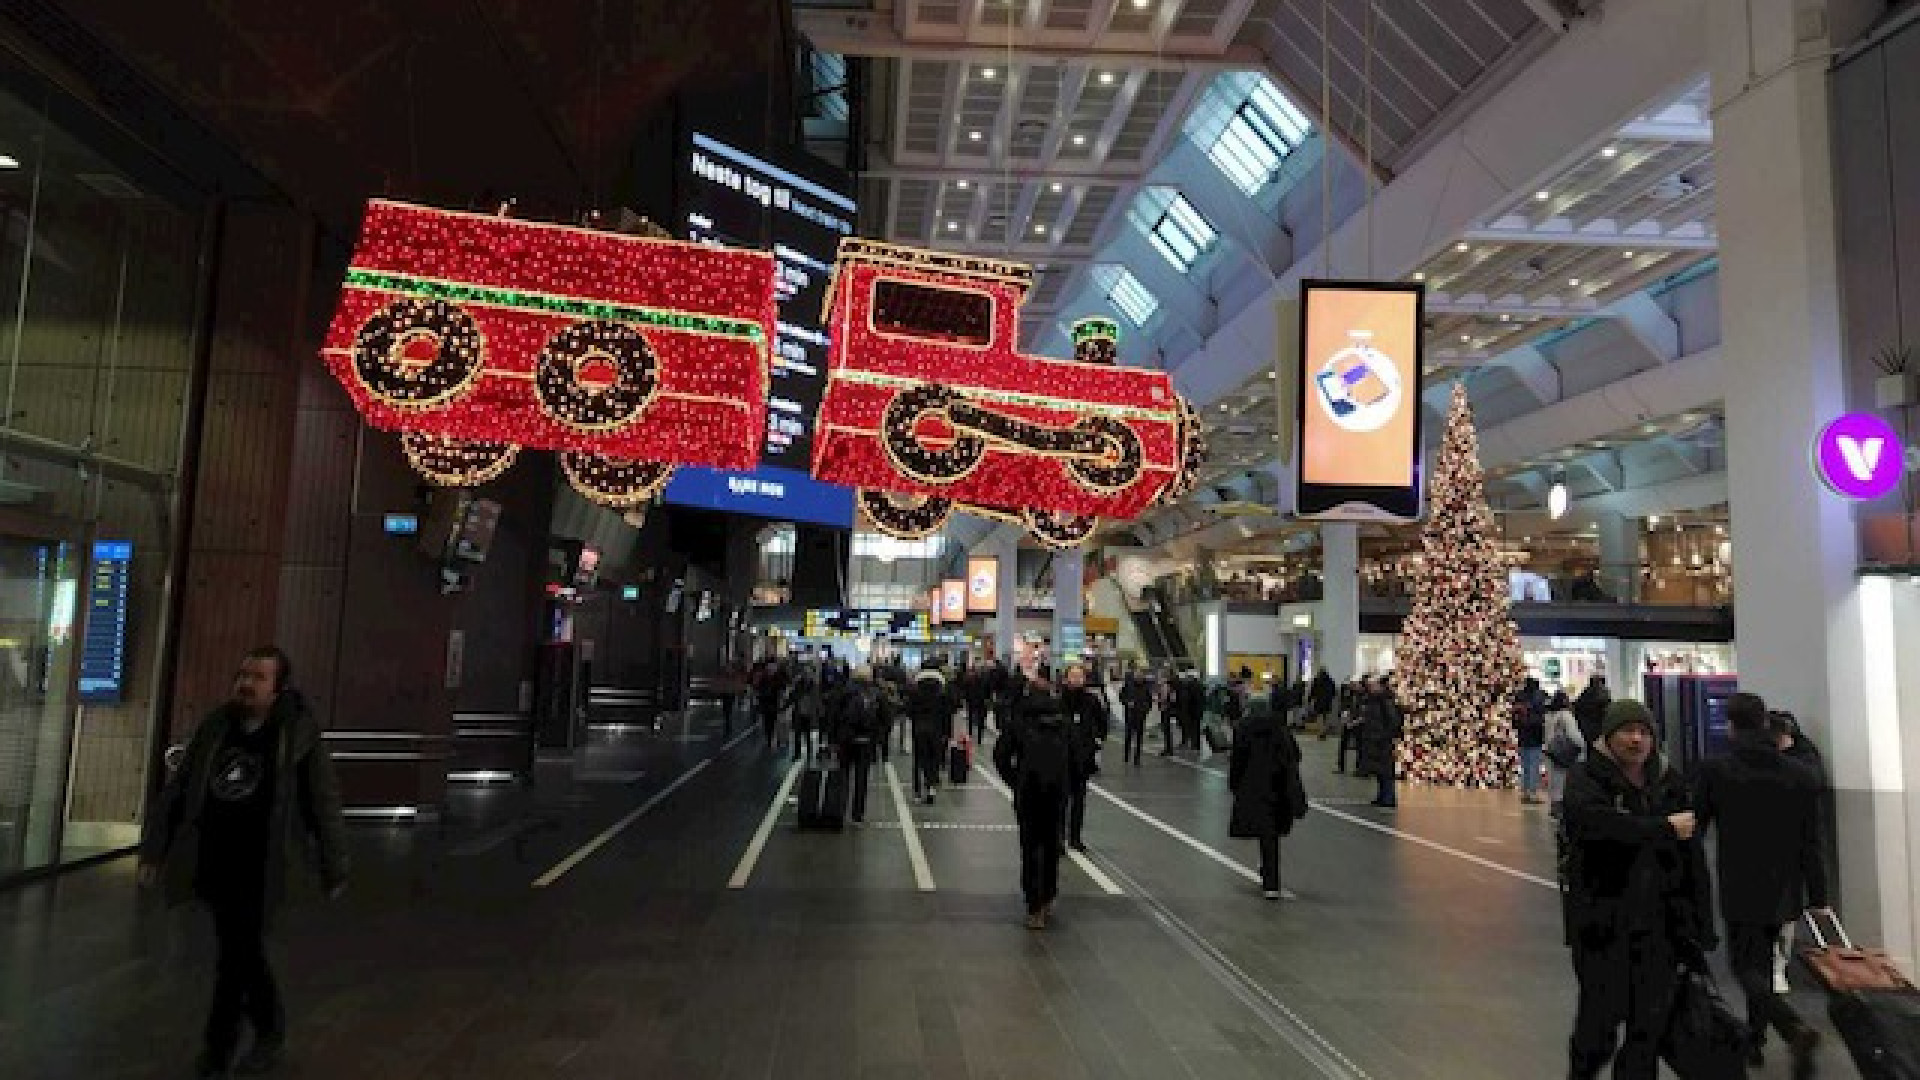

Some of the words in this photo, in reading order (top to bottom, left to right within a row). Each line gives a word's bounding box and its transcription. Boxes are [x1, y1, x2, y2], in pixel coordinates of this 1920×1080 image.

[692, 153, 742, 190] Neste
[744, 176, 771, 207] tog
[1836, 435, 1885, 481] V
